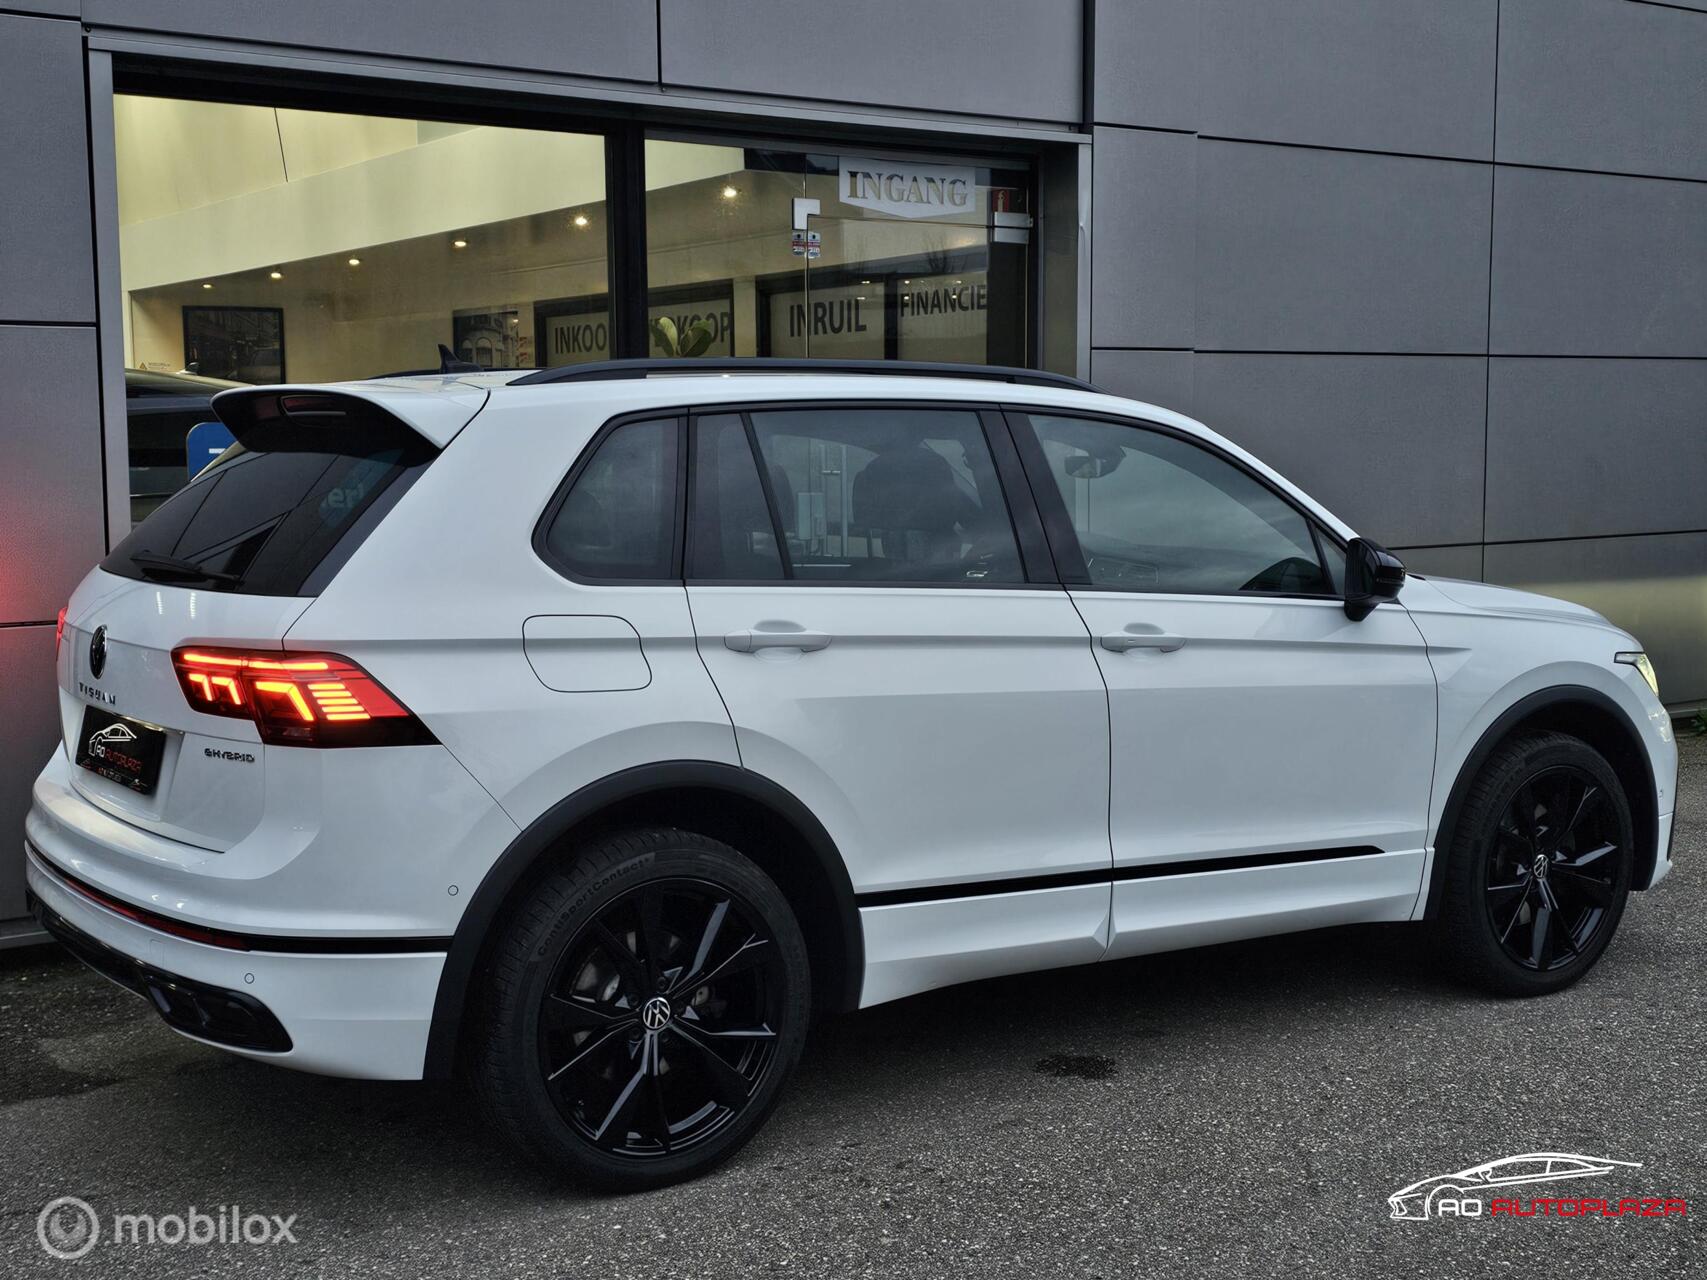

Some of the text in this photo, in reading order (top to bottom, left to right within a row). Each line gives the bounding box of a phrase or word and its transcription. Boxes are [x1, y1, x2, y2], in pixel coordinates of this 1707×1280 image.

[847, 170, 967, 207] INGANG
[789, 298, 867, 337] INRUIL
[554, 323, 607, 354] INKOO
